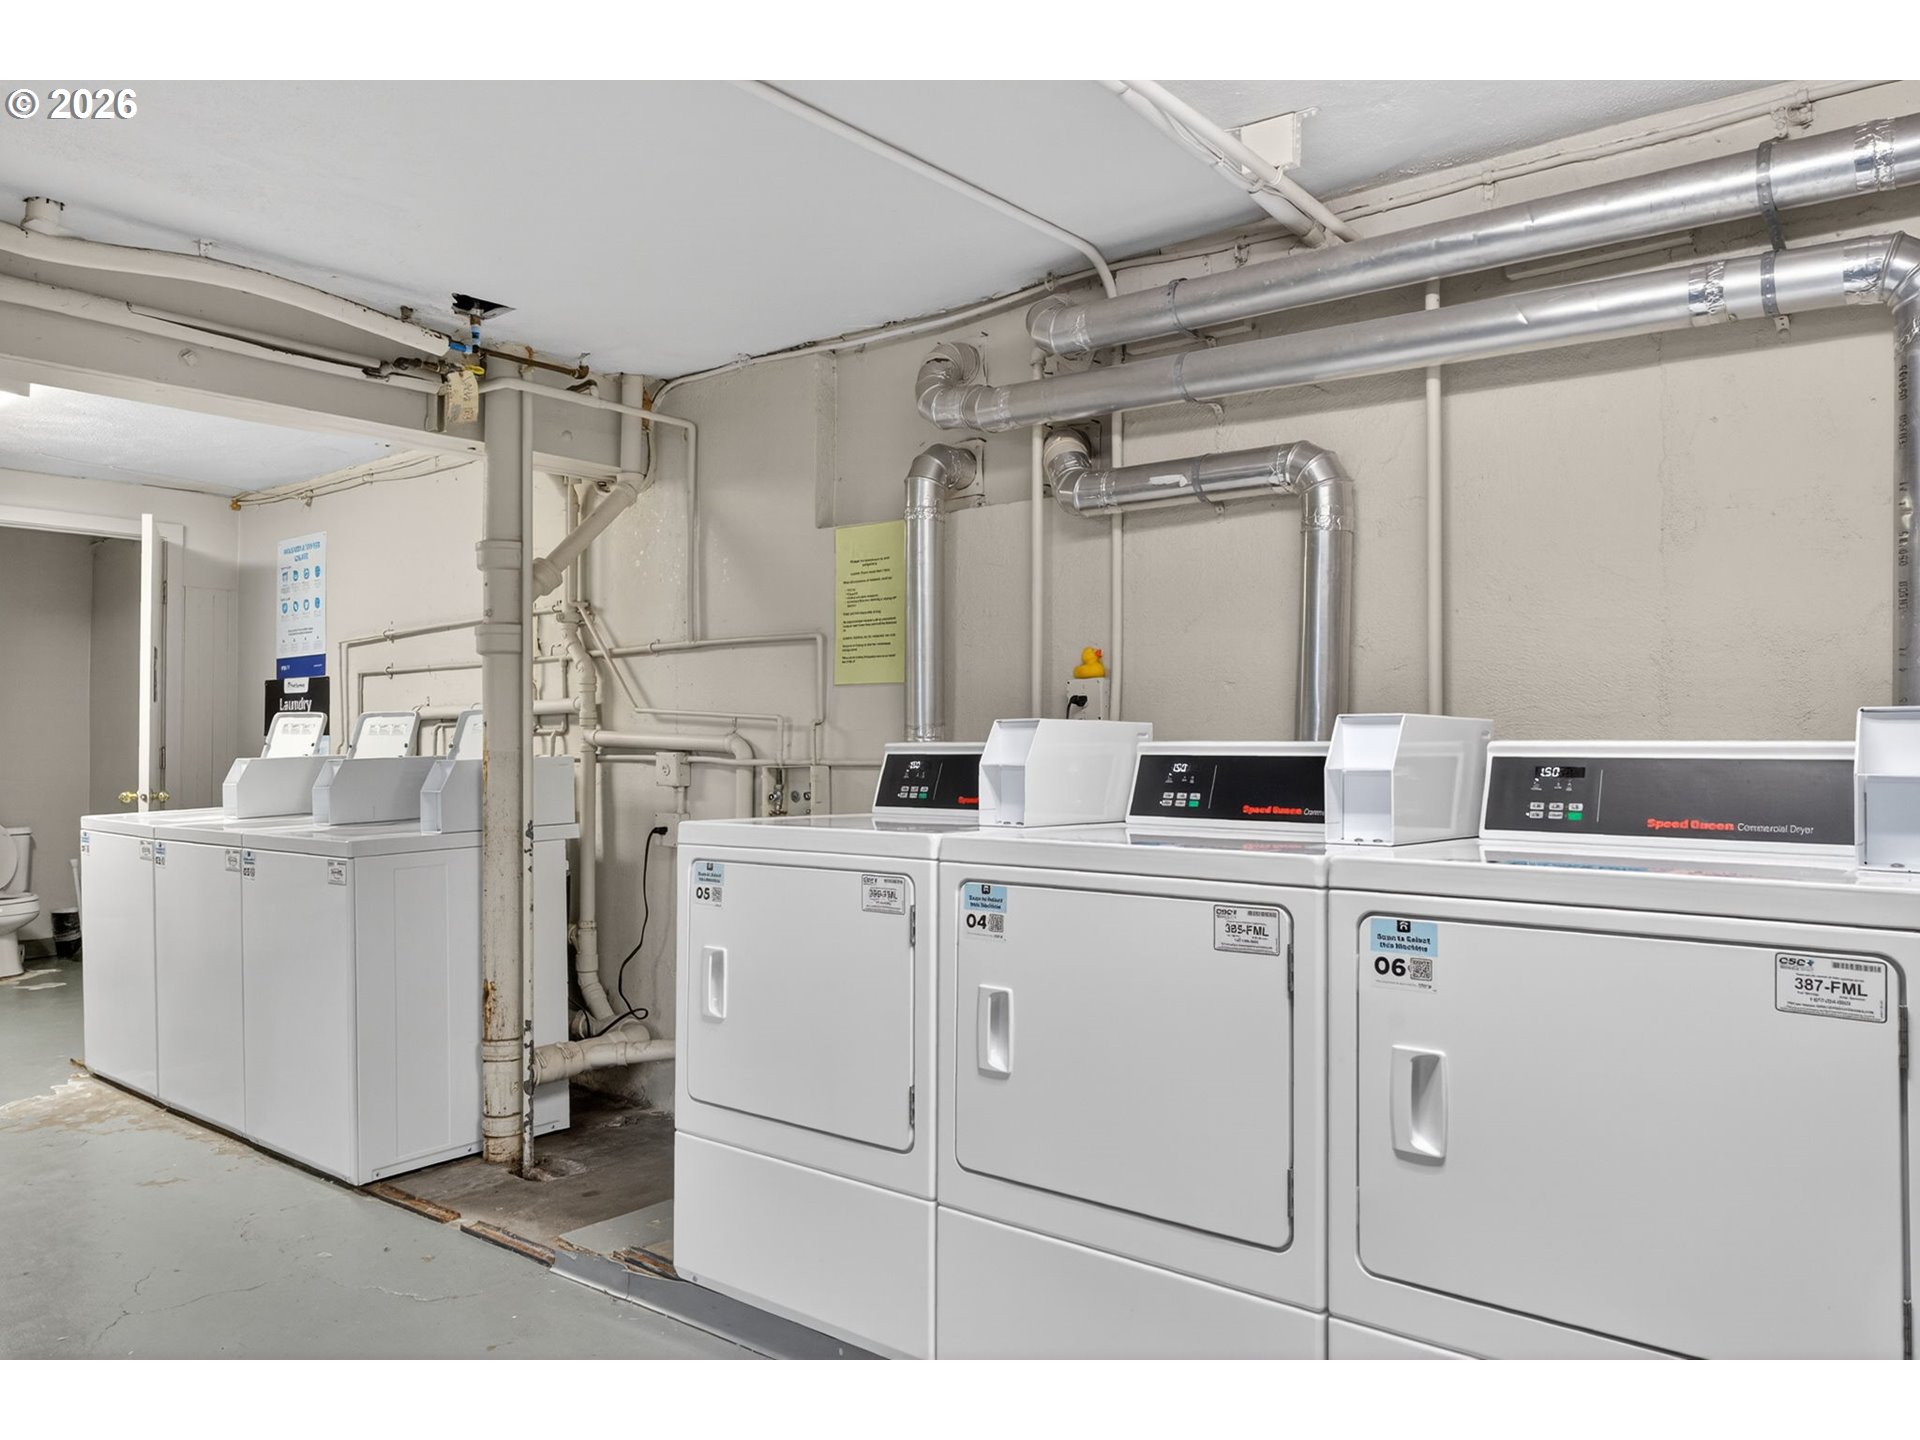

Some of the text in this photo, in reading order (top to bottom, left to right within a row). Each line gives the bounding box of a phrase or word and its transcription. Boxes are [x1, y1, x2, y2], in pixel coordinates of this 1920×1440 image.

[279, 697, 312, 712] Laundry
[1647, 818, 1814, 835] Speed Queen Commercial Dryer
[696, 887, 710, 900] 05
[966, 913, 987, 929] 04
[1374, 956, 1406, 977] 06
[1794, 977, 1868, 996] 387-FML
